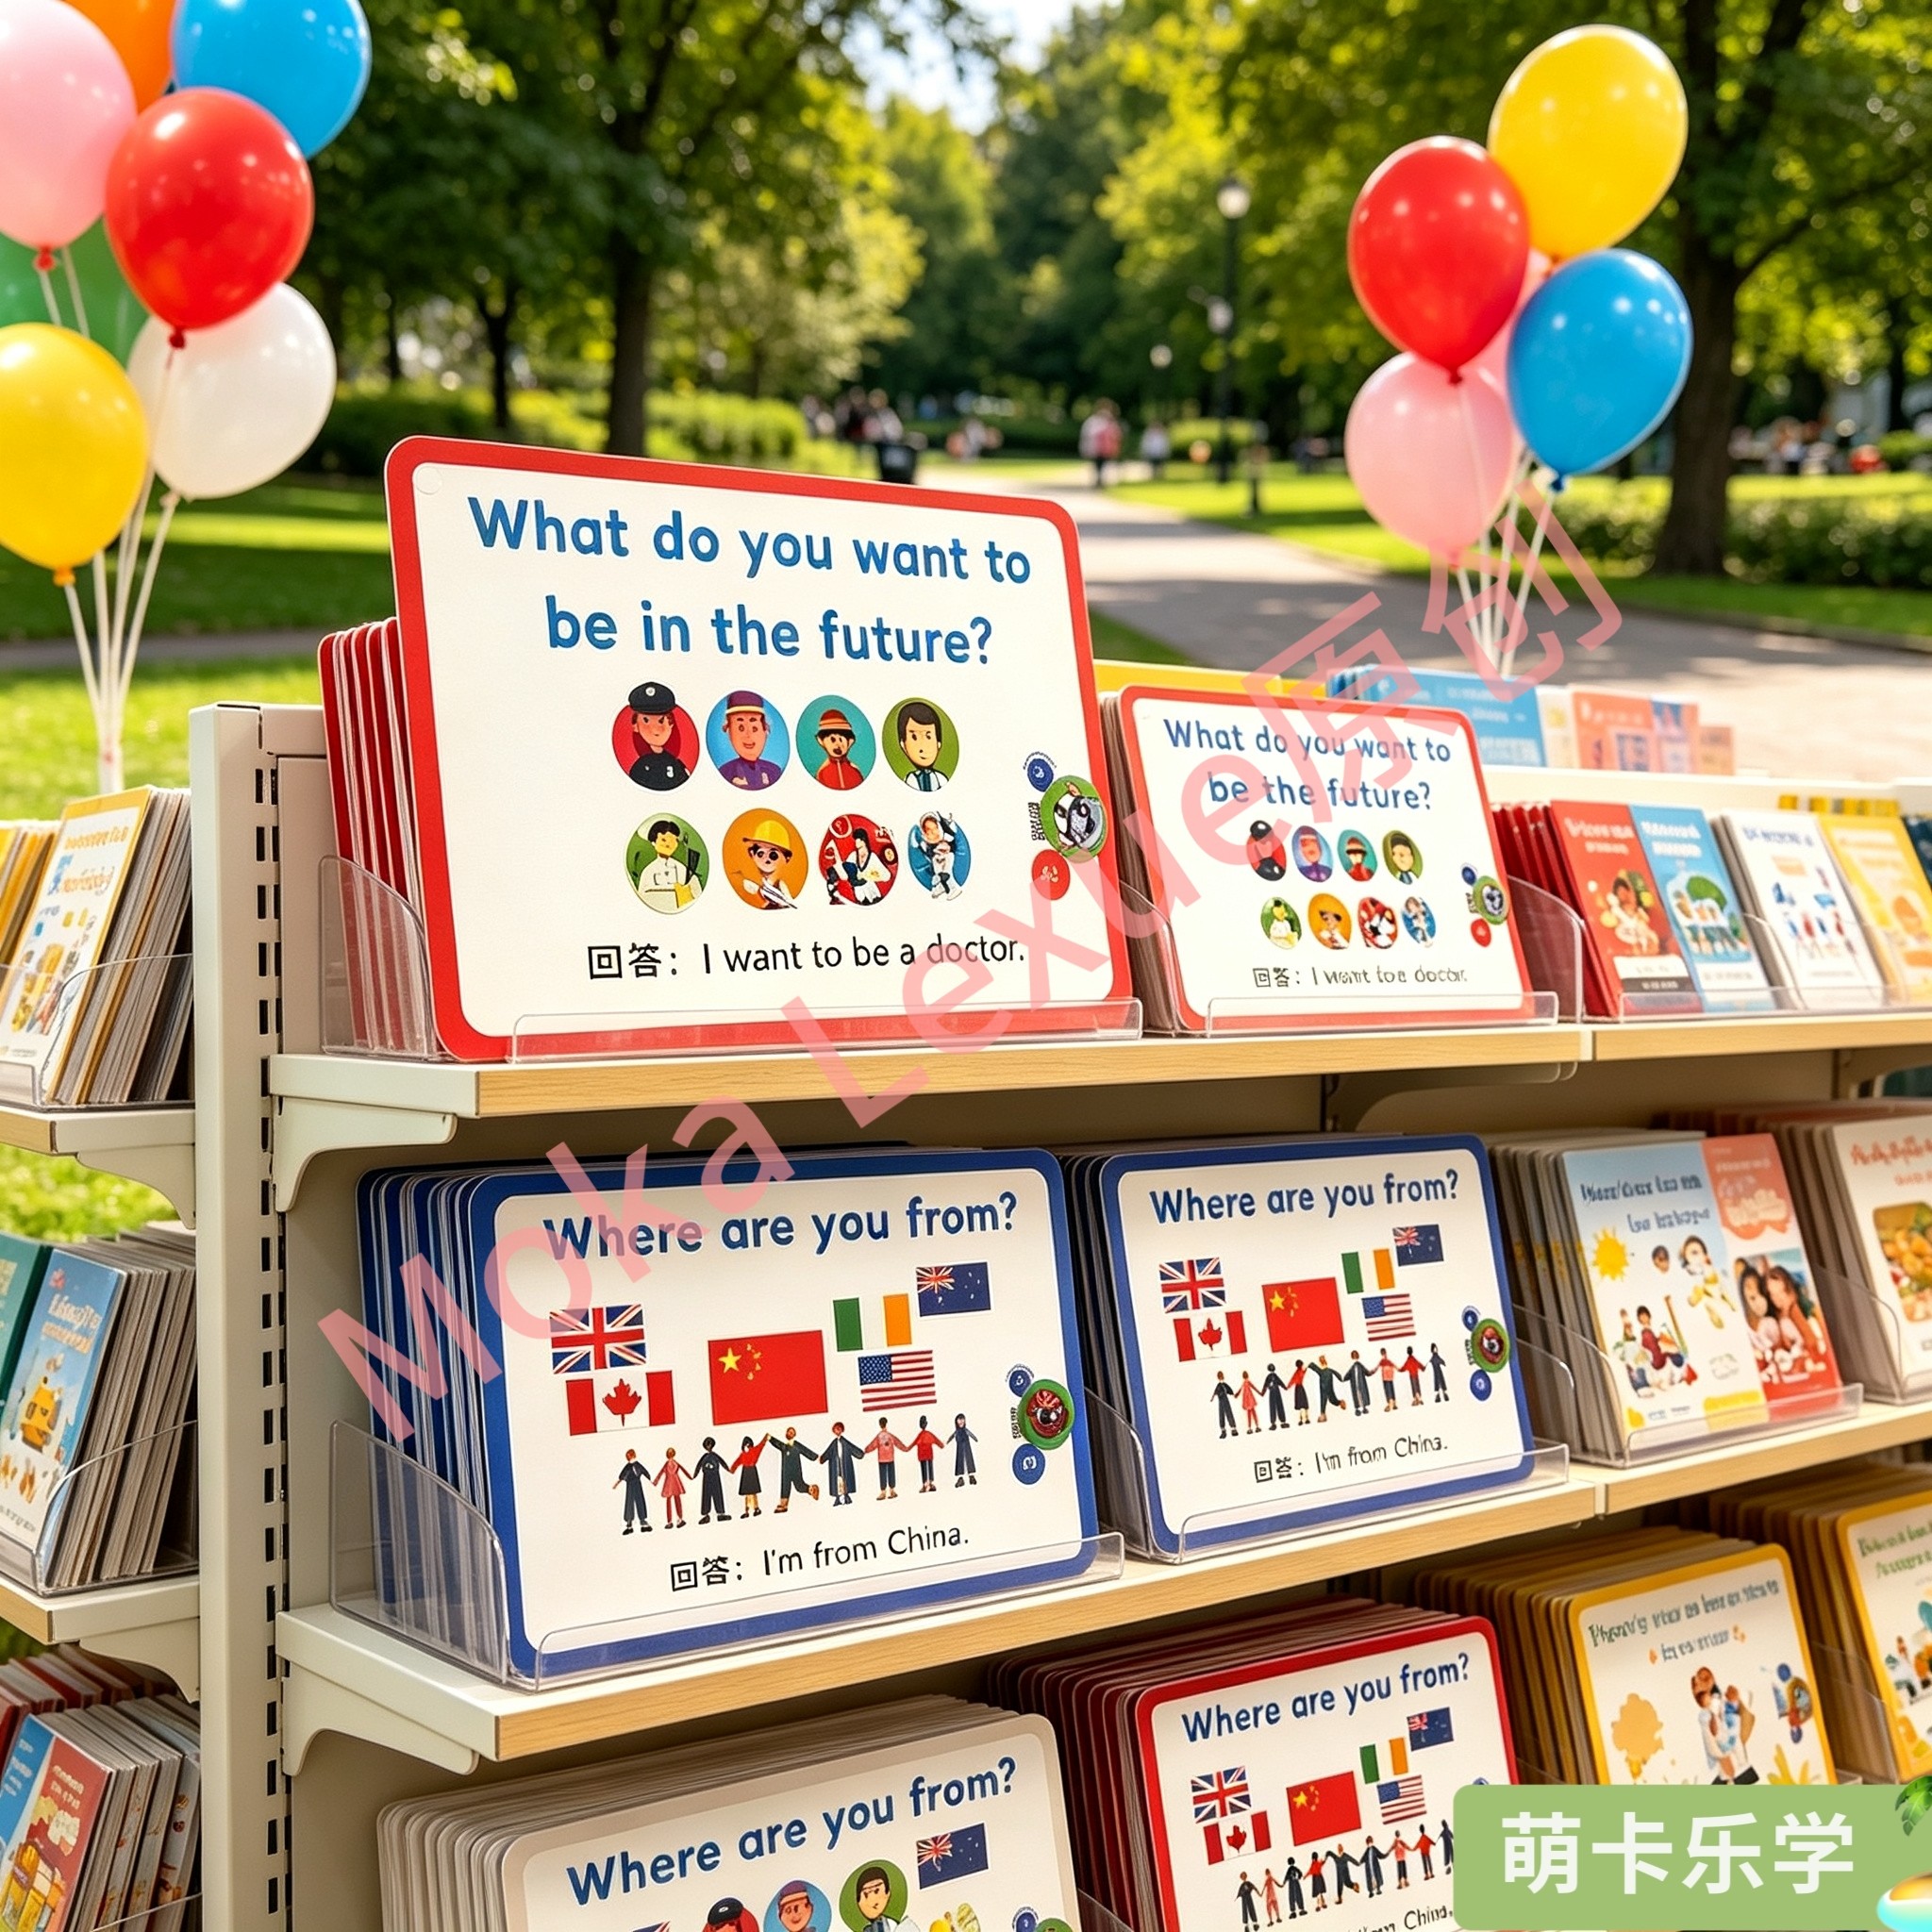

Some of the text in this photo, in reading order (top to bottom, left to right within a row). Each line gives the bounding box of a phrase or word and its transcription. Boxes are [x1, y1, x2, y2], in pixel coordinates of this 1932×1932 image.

[468, 497, 1030, 583] What do you want to
[546, 595, 991, 664] be in the future?
[1163, 719, 1451, 762] What do you want to
[1208, 772, 1431, 809] be the future?
[704, 943, 710, 974] I
[724, 943, 802, 972] want
[812, 941, 841, 968] to
[853, 937, 889, 966] be
[901, 944, 914, 965] a
[926, 933, 1024, 963] doctor.
[543, 1191, 1016, 1261] Where are you from?
[1150, 1169, 1457, 1223] Where are you from?
[764, 1550, 802, 1575] I'm
[814, 1541, 876, 1568] from
[889, 1526, 969, 1555] China.
[1181, 1653, 1468, 1742] Where are you from?
[566, 1757, 1015, 1906] Where are you from?
